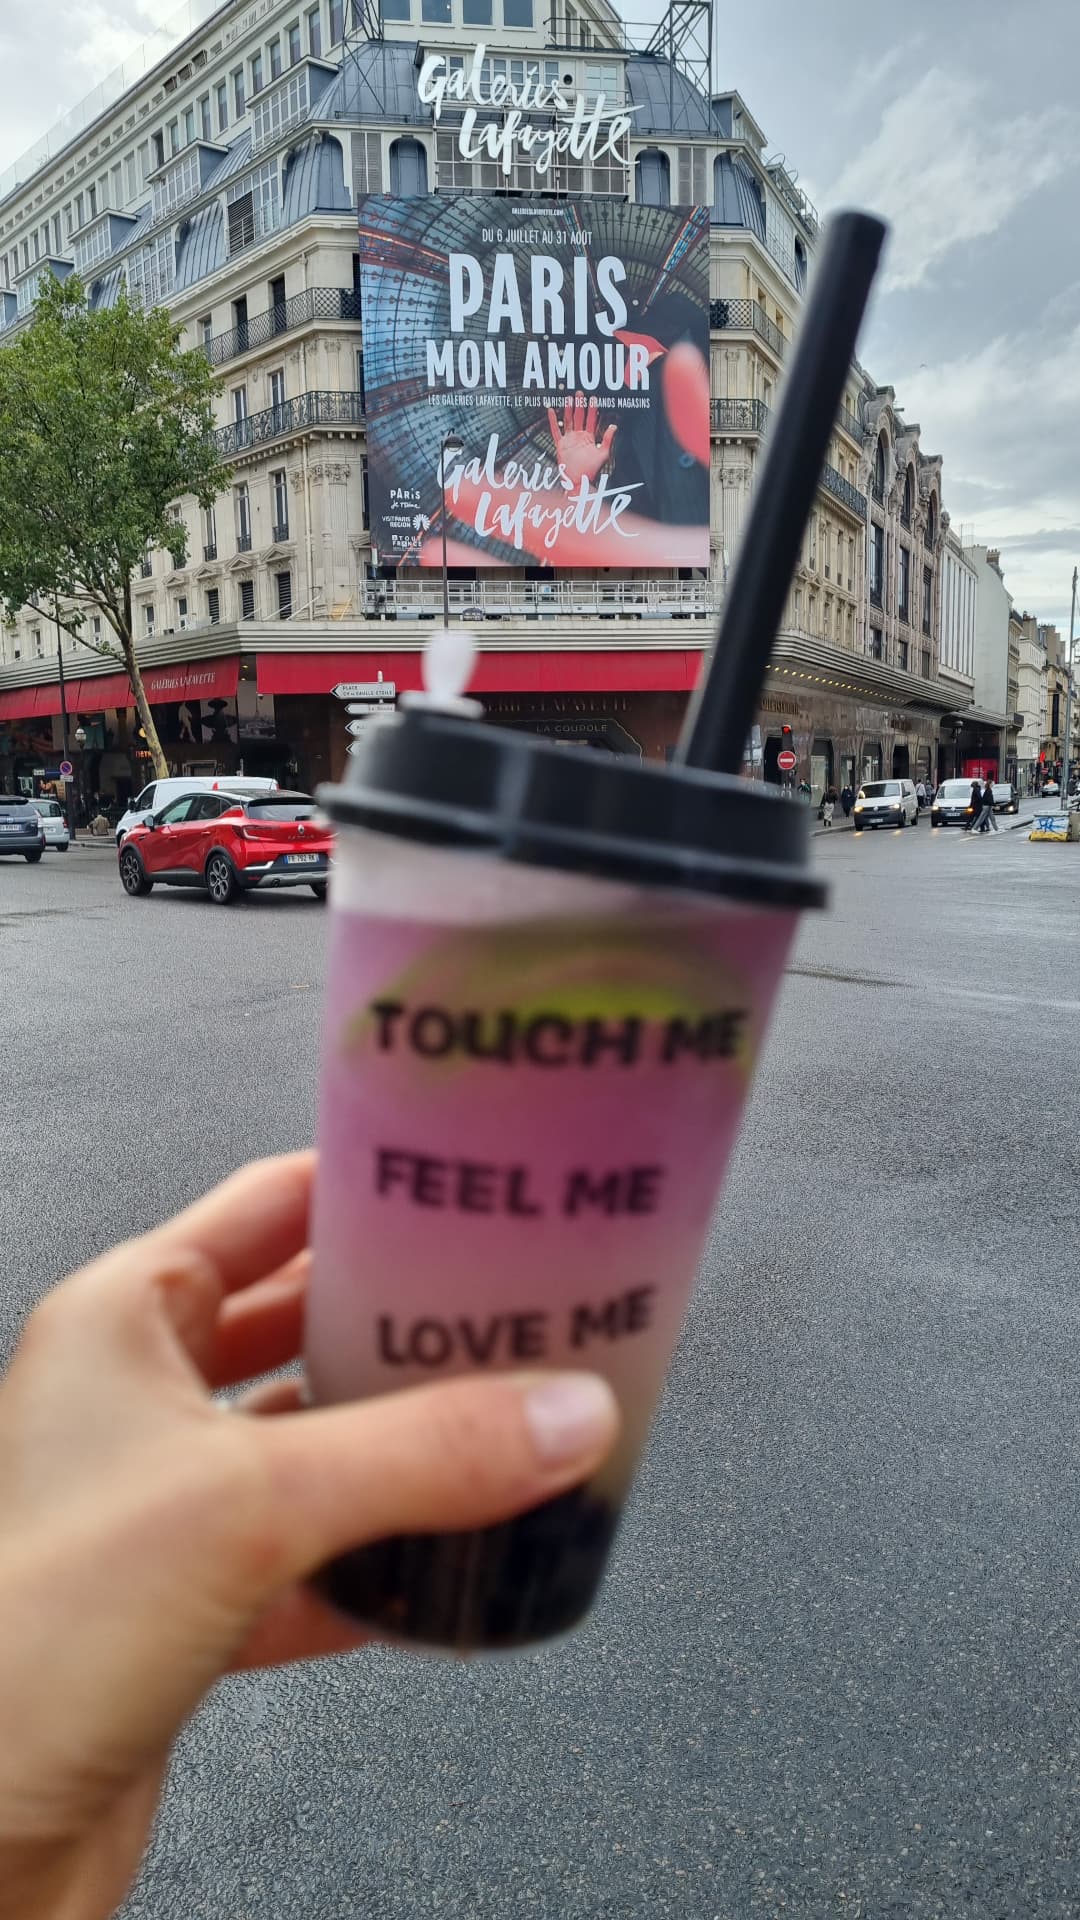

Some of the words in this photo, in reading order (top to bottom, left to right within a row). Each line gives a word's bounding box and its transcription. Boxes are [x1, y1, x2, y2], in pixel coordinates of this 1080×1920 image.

[417, 43, 570, 120] Galeries
[458, 94, 646, 175] Lafayette
[482, 228, 494, 242] DU
[496, 229, 503, 242] 6
[505, 229, 539, 244] JUILLET
[542, 230, 553, 244] AU
[556, 230, 567, 244] 31
[449, 252, 628, 337] PARIS
[426, 339, 507, 389] MON
[522, 342, 650, 391] AMOUR
[428, 394, 440, 406] LES
[442, 394, 474, 406] GALERIES
[475, 395, 513, 408] LAFAYETTE,
[514, 395, 523, 407] LE
[524, 396, 541, 408] PLUS
[543, 396, 573, 408] PARISIEN
[575, 397, 588, 408] DES
[589, 397, 616, 408] GRANDS
[617, 397, 651, 409] MAGASINS
[436, 433, 574, 504] Galeries
[474, 474, 646, 549] Lafayette
[536, 724, 550, 733] LA
[554, 724, 608, 733] COUPOLE
[371, 998, 642, 1067] TOUCH
[660, 1008, 748, 1064] ME
[374, 1146, 542, 1218] FEEL
[562, 1163, 665, 1219] ME
[378, 1309, 549, 1366] LOVE
[569, 1283, 657, 1350] ME
